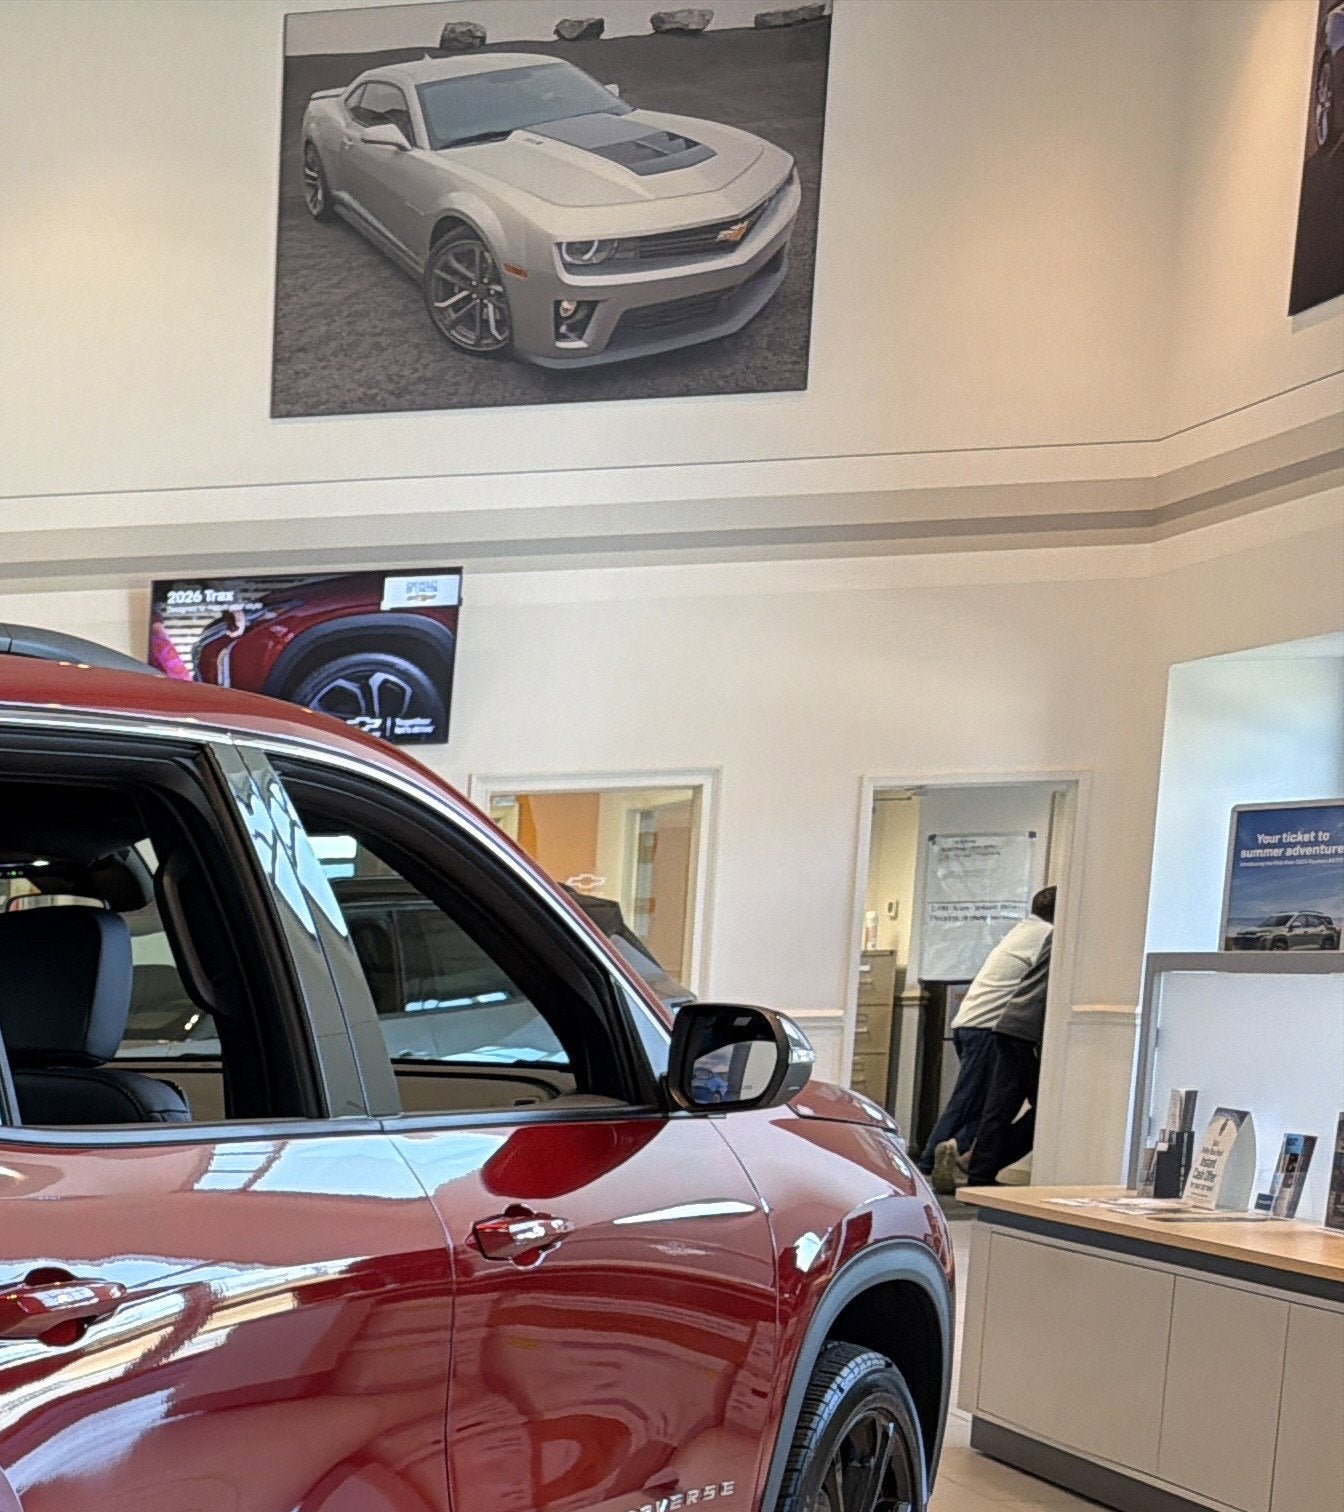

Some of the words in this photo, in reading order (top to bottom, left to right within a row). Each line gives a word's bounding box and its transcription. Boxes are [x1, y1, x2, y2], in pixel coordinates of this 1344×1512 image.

[167, 590, 203, 604] 2026
[204, 589, 234, 602] Trax
[1257, 833, 1281, 844] Your
[1282, 831, 1316, 843] ticket
[1317, 831, 1330, 841] to
[1241, 847, 1284, 858] summer
[1285, 844, 1344, 857] adventure
